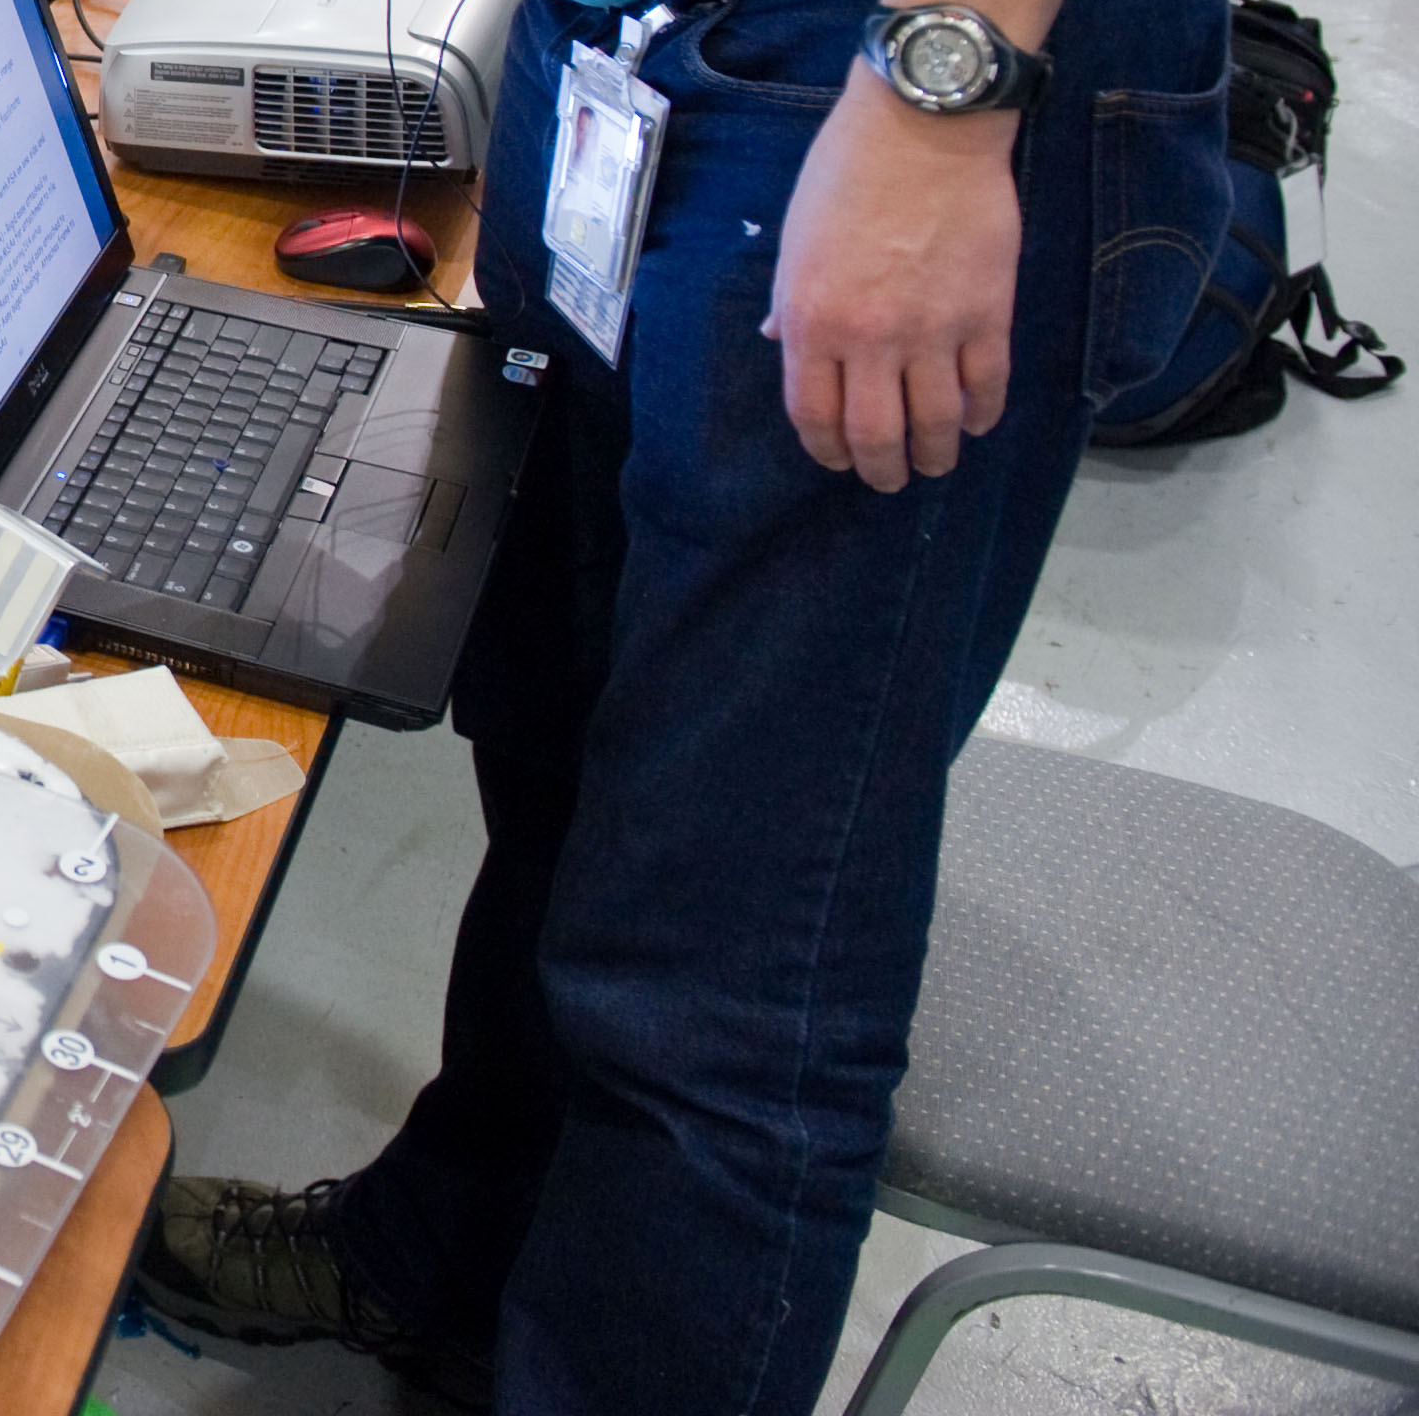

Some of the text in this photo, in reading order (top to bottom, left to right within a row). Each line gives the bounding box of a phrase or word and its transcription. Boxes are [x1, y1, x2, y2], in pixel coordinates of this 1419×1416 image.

[73, 858, 96, 876] 2
[110, 954, 135, 969] 1
[52, 1037, 88, 1067] 30
